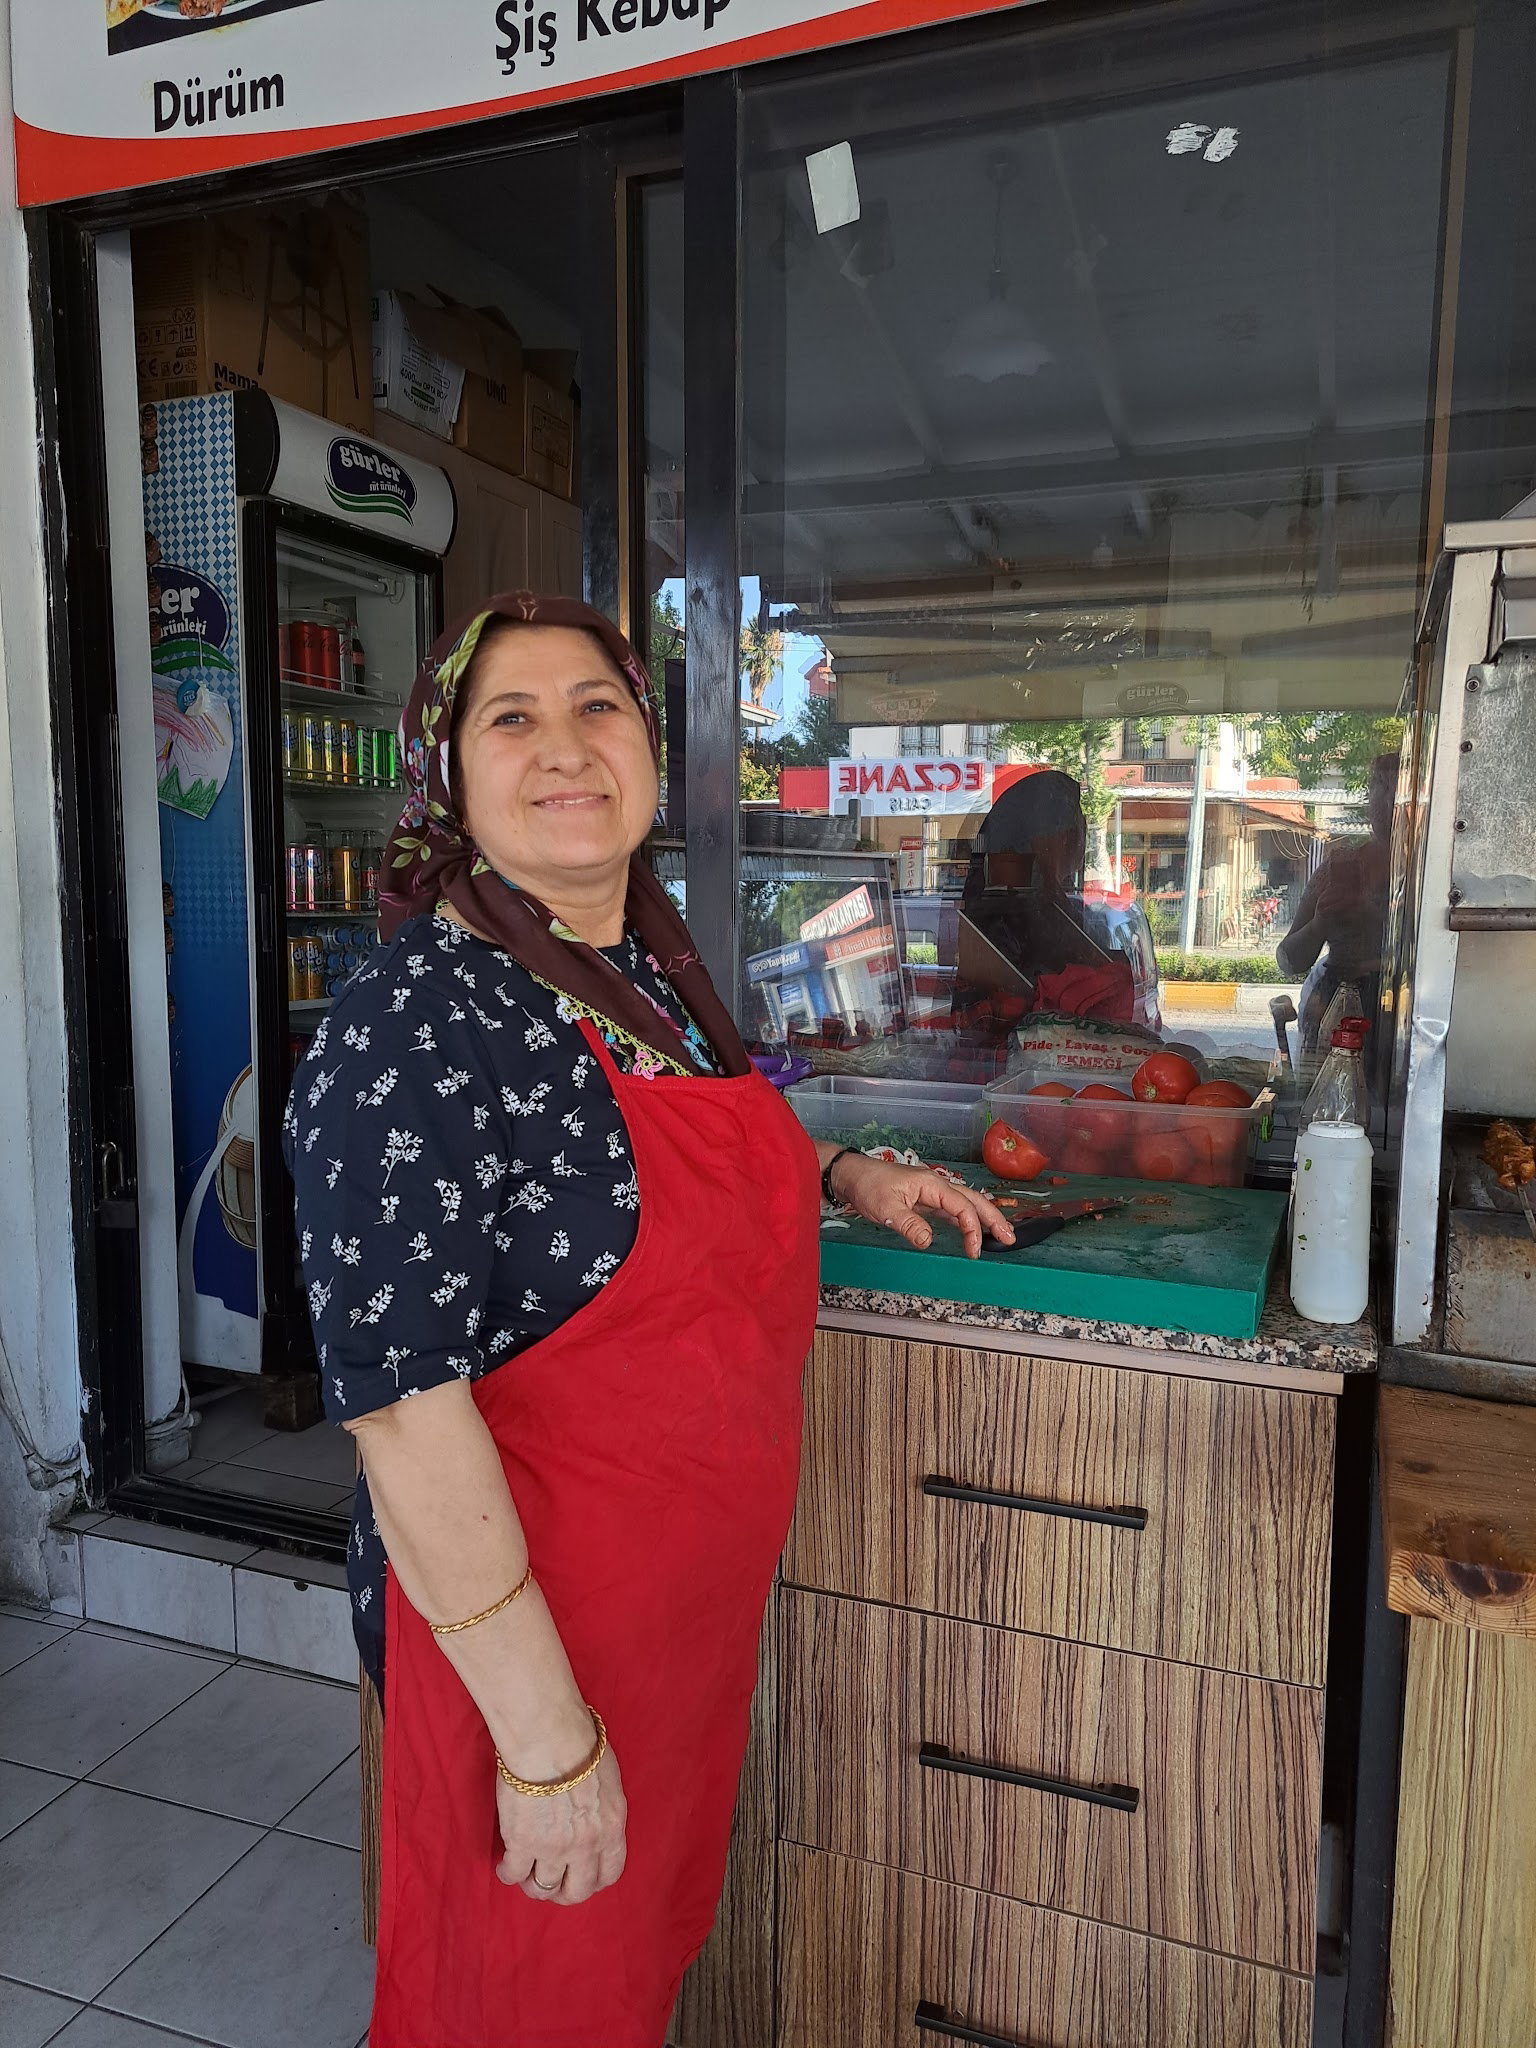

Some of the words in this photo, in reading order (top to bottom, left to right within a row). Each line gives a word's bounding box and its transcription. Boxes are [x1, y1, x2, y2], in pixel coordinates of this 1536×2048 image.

[495, 0, 558, 75] Şiş
[153, 67, 284, 133] Dürüm
[214, 362, 259, 391] Mama
[339, 444, 401, 482] gürler
[379, 481, 407, 499] ürünleri
[1126, 685, 1178, 700] gürler
[1023, 1039, 1053, 1051] Pide
[1065, 1039, 1108, 1054] Lavaş
[1057, 1054, 1122, 1071] EKMEĞİ
